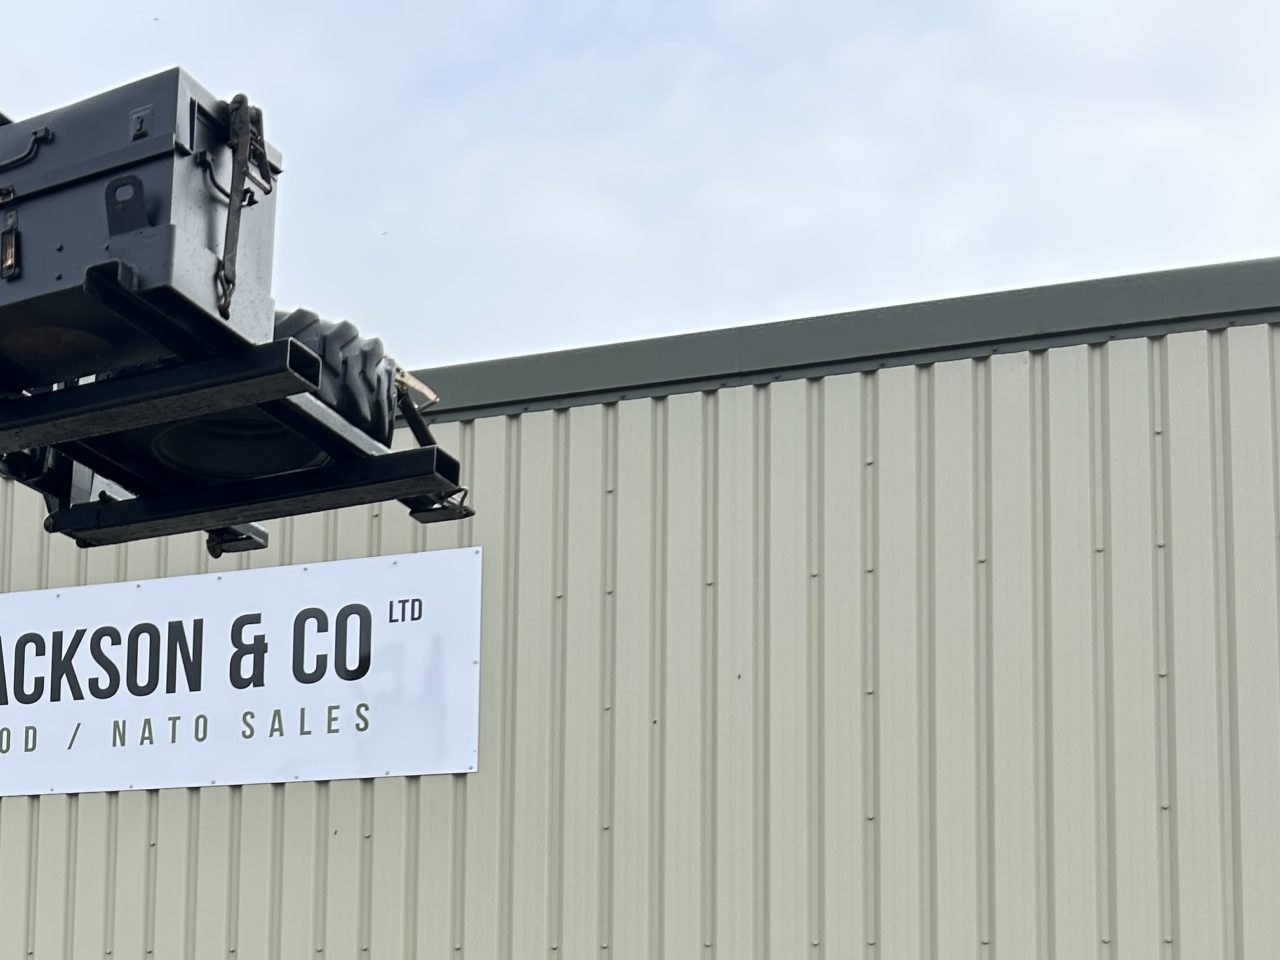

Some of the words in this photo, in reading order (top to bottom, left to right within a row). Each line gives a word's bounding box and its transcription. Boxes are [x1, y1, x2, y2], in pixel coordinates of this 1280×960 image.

[228, 612, 269, 690] &
[291, 603, 373, 685] CO
[388, 598, 423, 624] LTD
[67, 722, 82, 751] /
[112, 714, 208, 748] NATO
[241, 702, 370, 740] SALES
